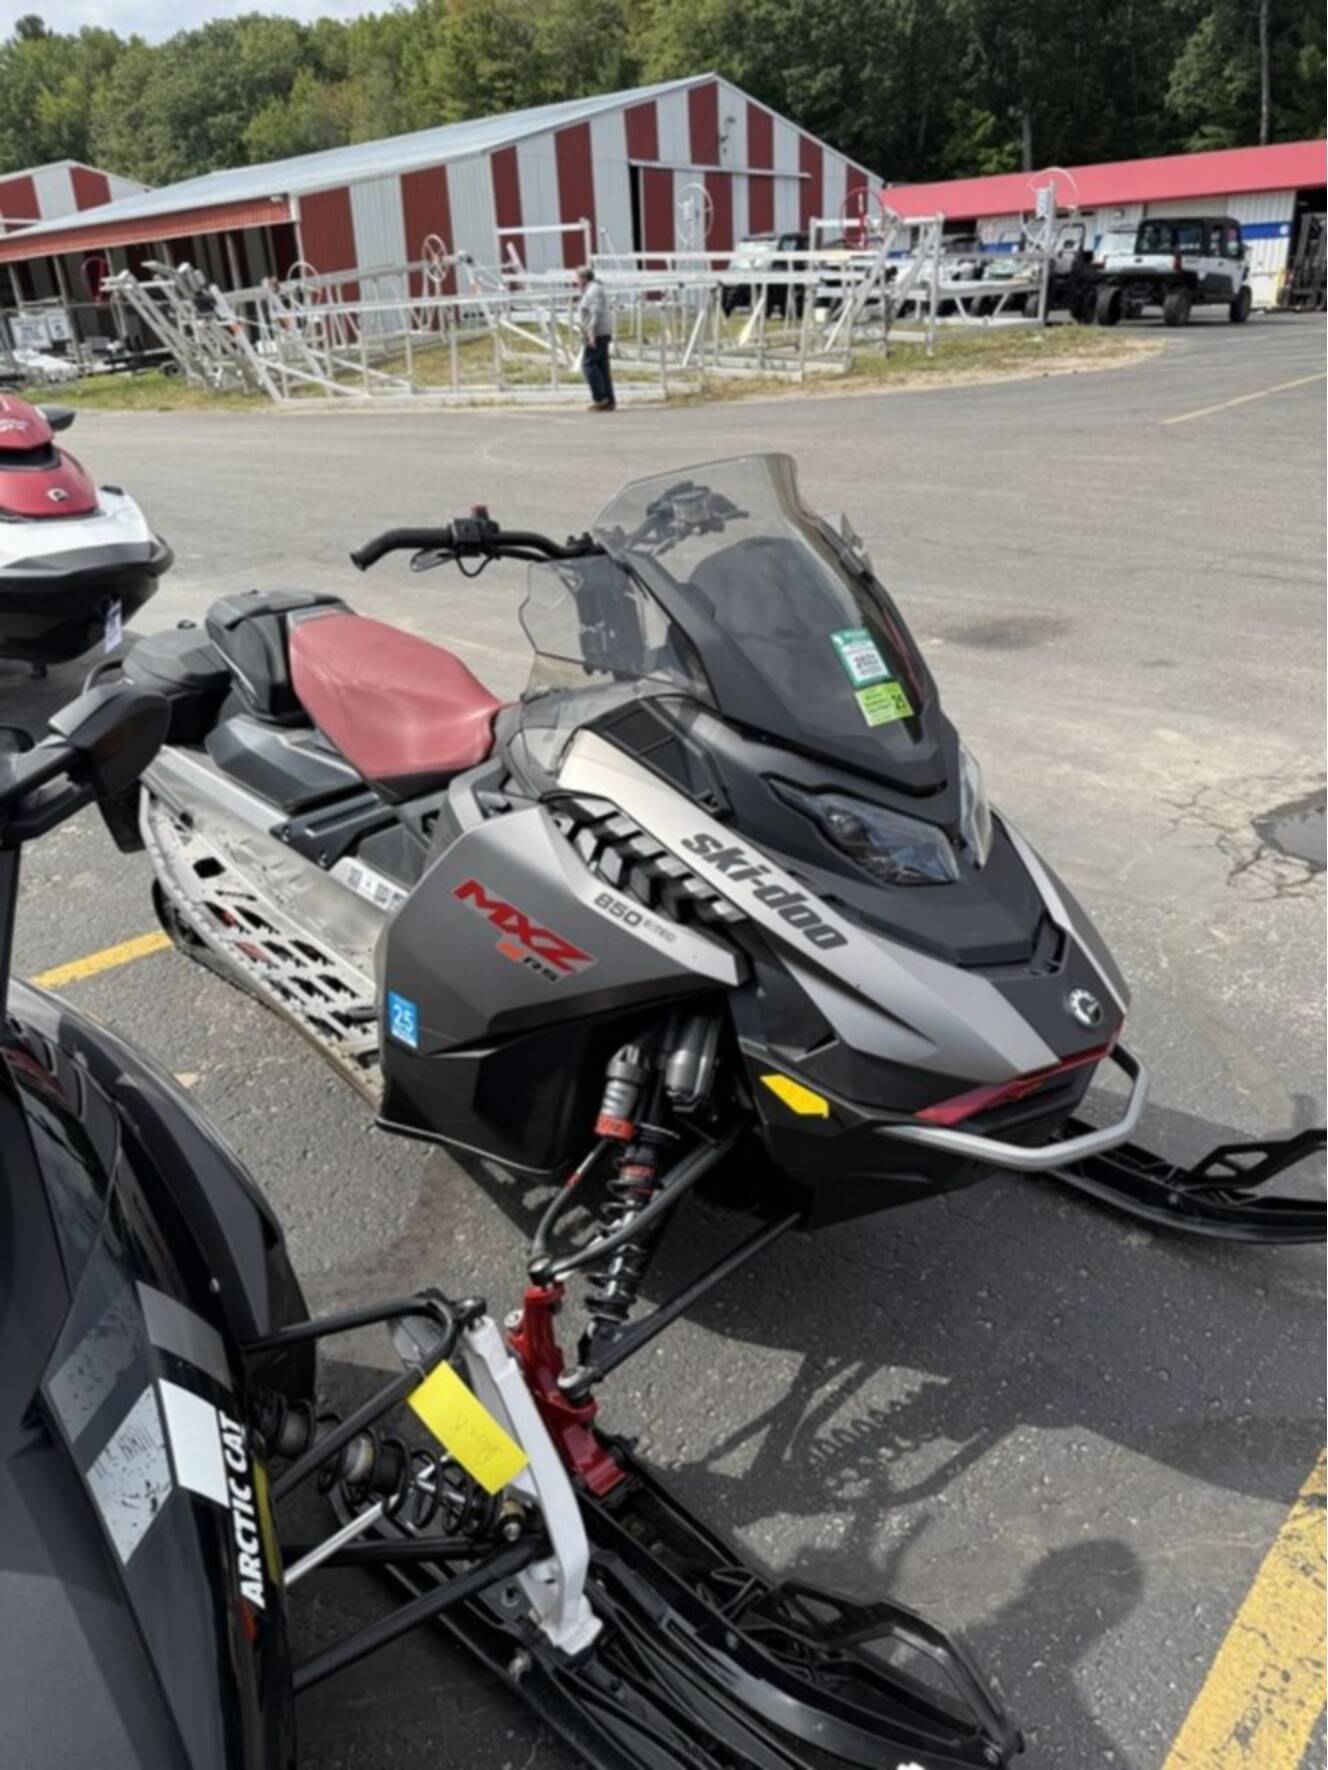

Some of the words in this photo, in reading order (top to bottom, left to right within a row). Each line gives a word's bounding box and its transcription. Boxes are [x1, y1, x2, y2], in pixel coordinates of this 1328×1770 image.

[453, 879, 595, 972] MXZ
[594, 892, 642, 926] 850
[681, 833, 848, 950] ski-doo
[393, 1003, 414, 1032] 25
[219, 1410, 247, 1473] CAT
[229, 1477, 266, 1610] ARCTIC
